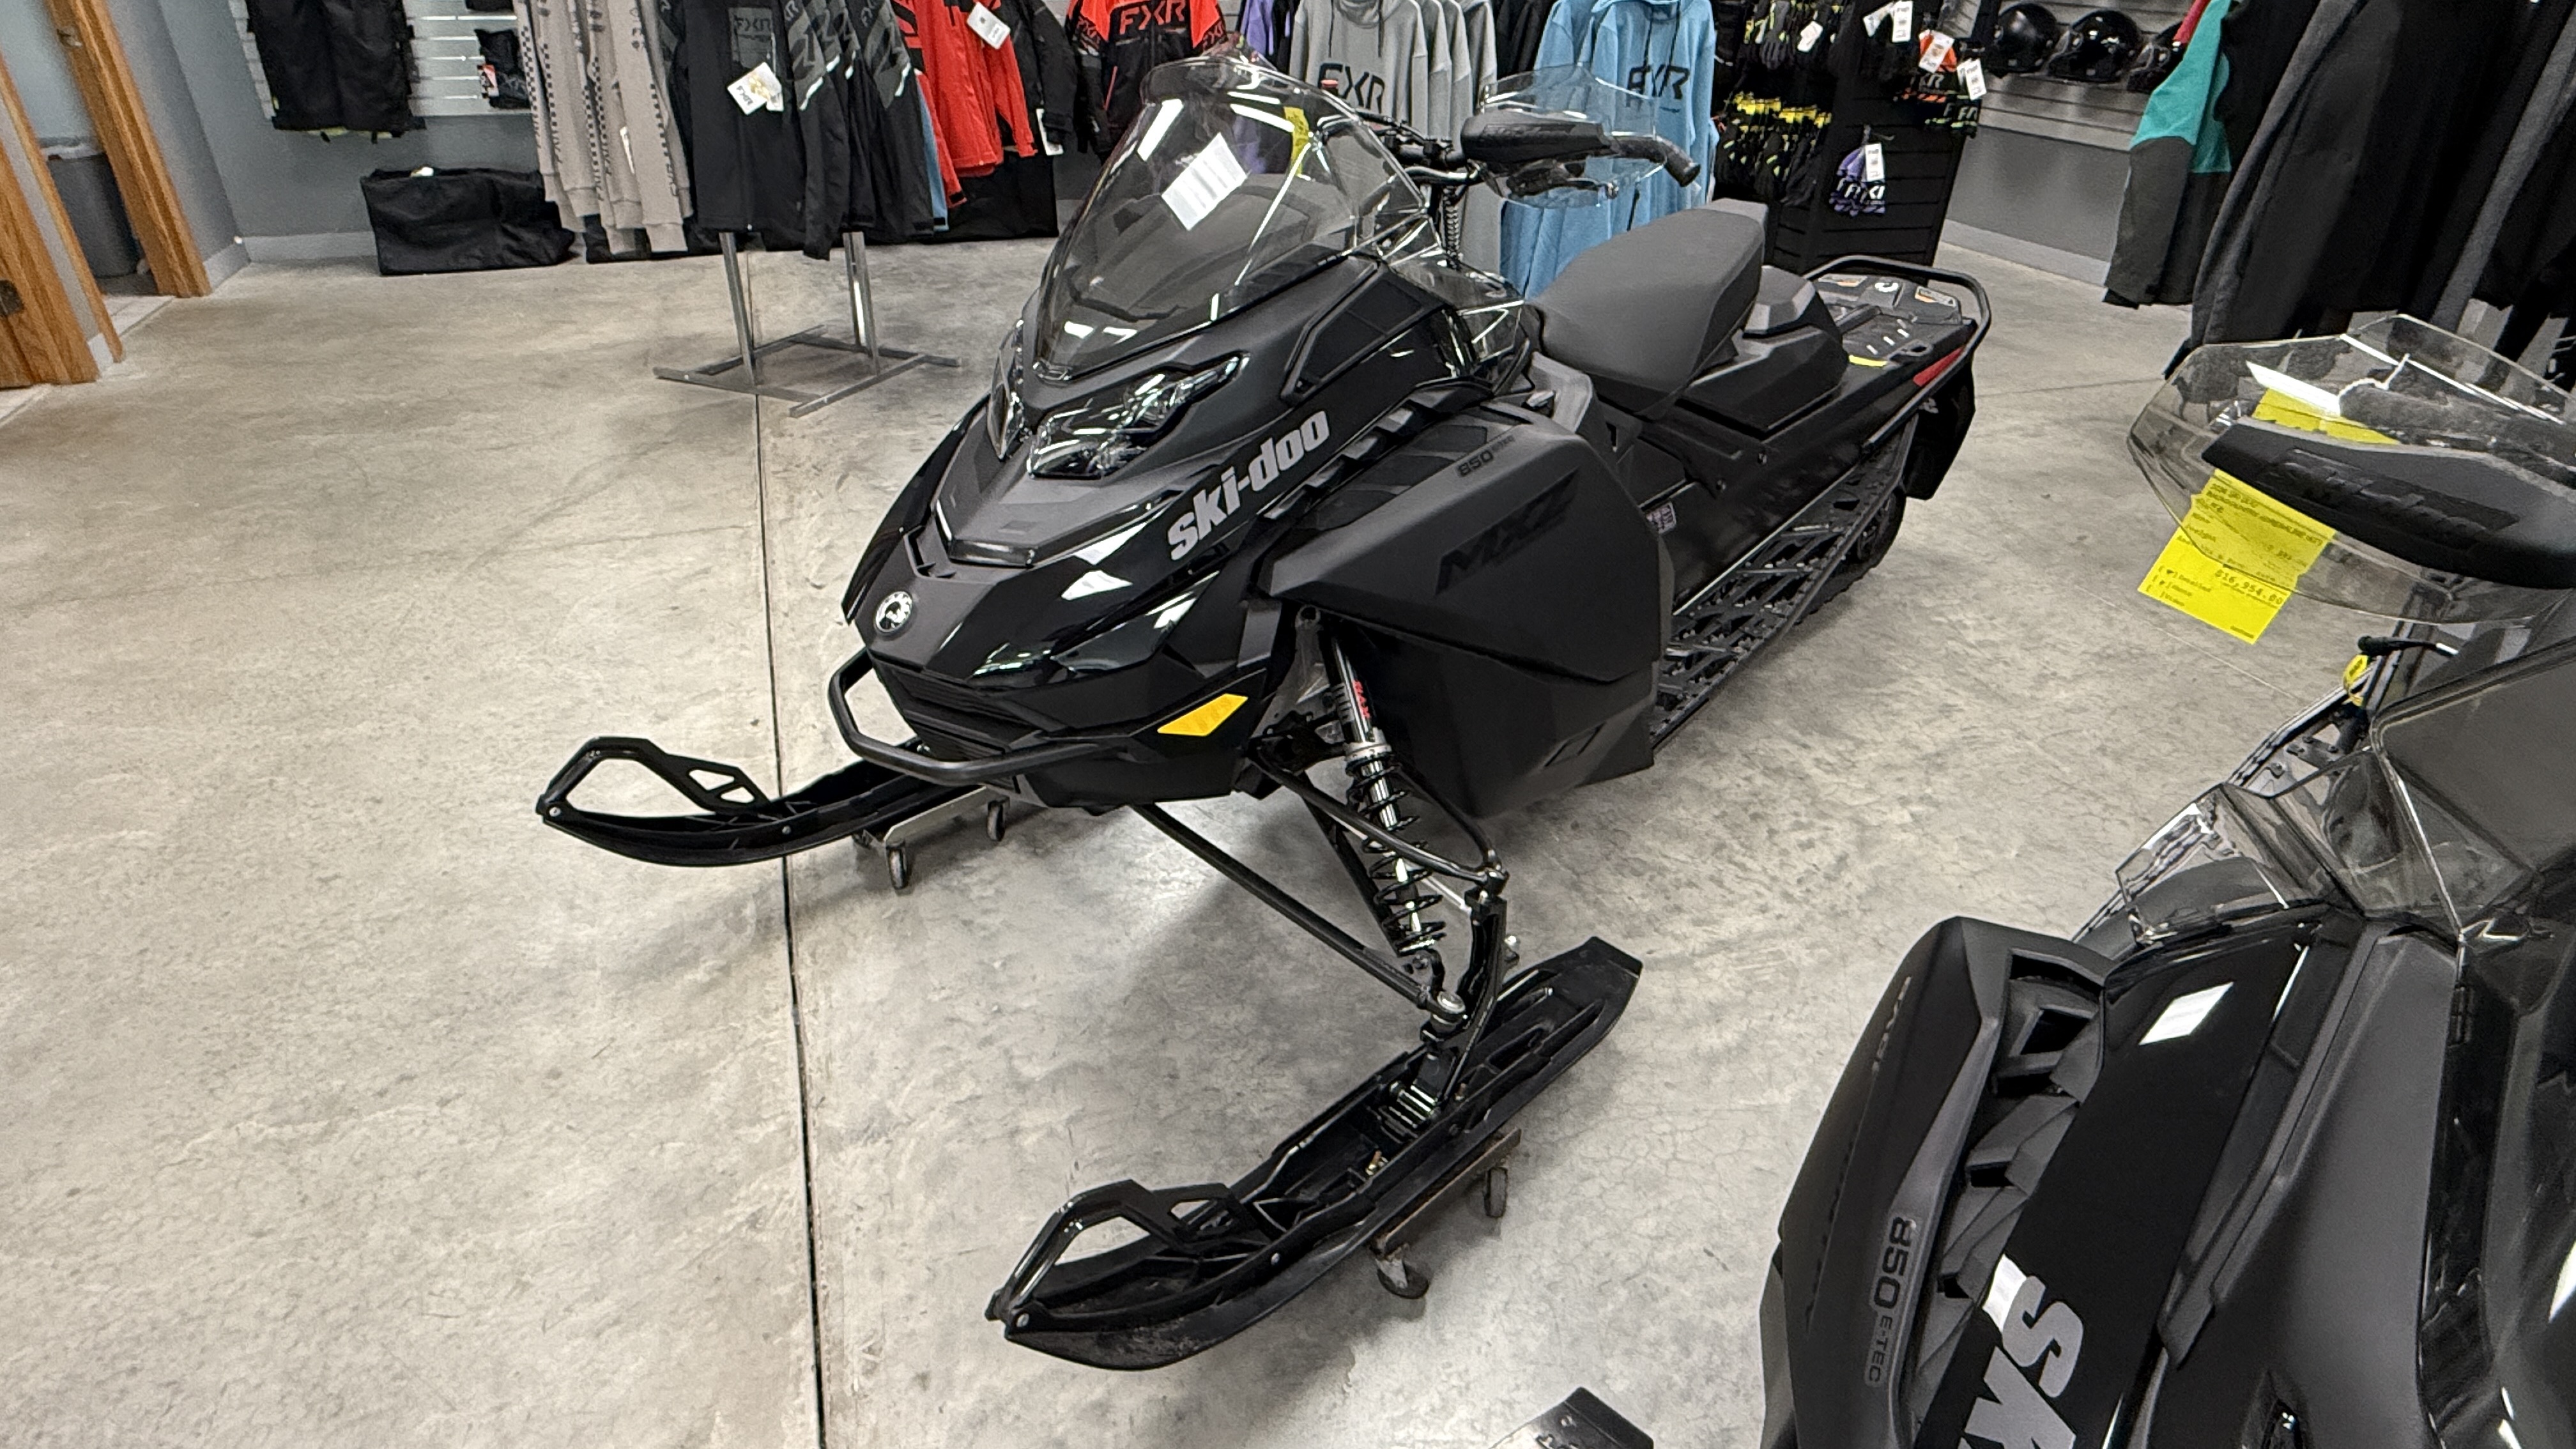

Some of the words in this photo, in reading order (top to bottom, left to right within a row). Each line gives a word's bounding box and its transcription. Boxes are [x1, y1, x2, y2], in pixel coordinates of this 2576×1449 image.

[1119, 0, 1186, 34] FXR
[1317, 63, 1385, 114] FXR
[1167, 410, 1330, 561] ski-doo
[1457, 449, 1495, 479] 850
[1436, 468, 1580, 595] MXZ
[1873, 1216, 1914, 1308] 850
[1868, 1315, 1892, 1383] E-TEC
[1959, 1275, 2085, 1449] sk
